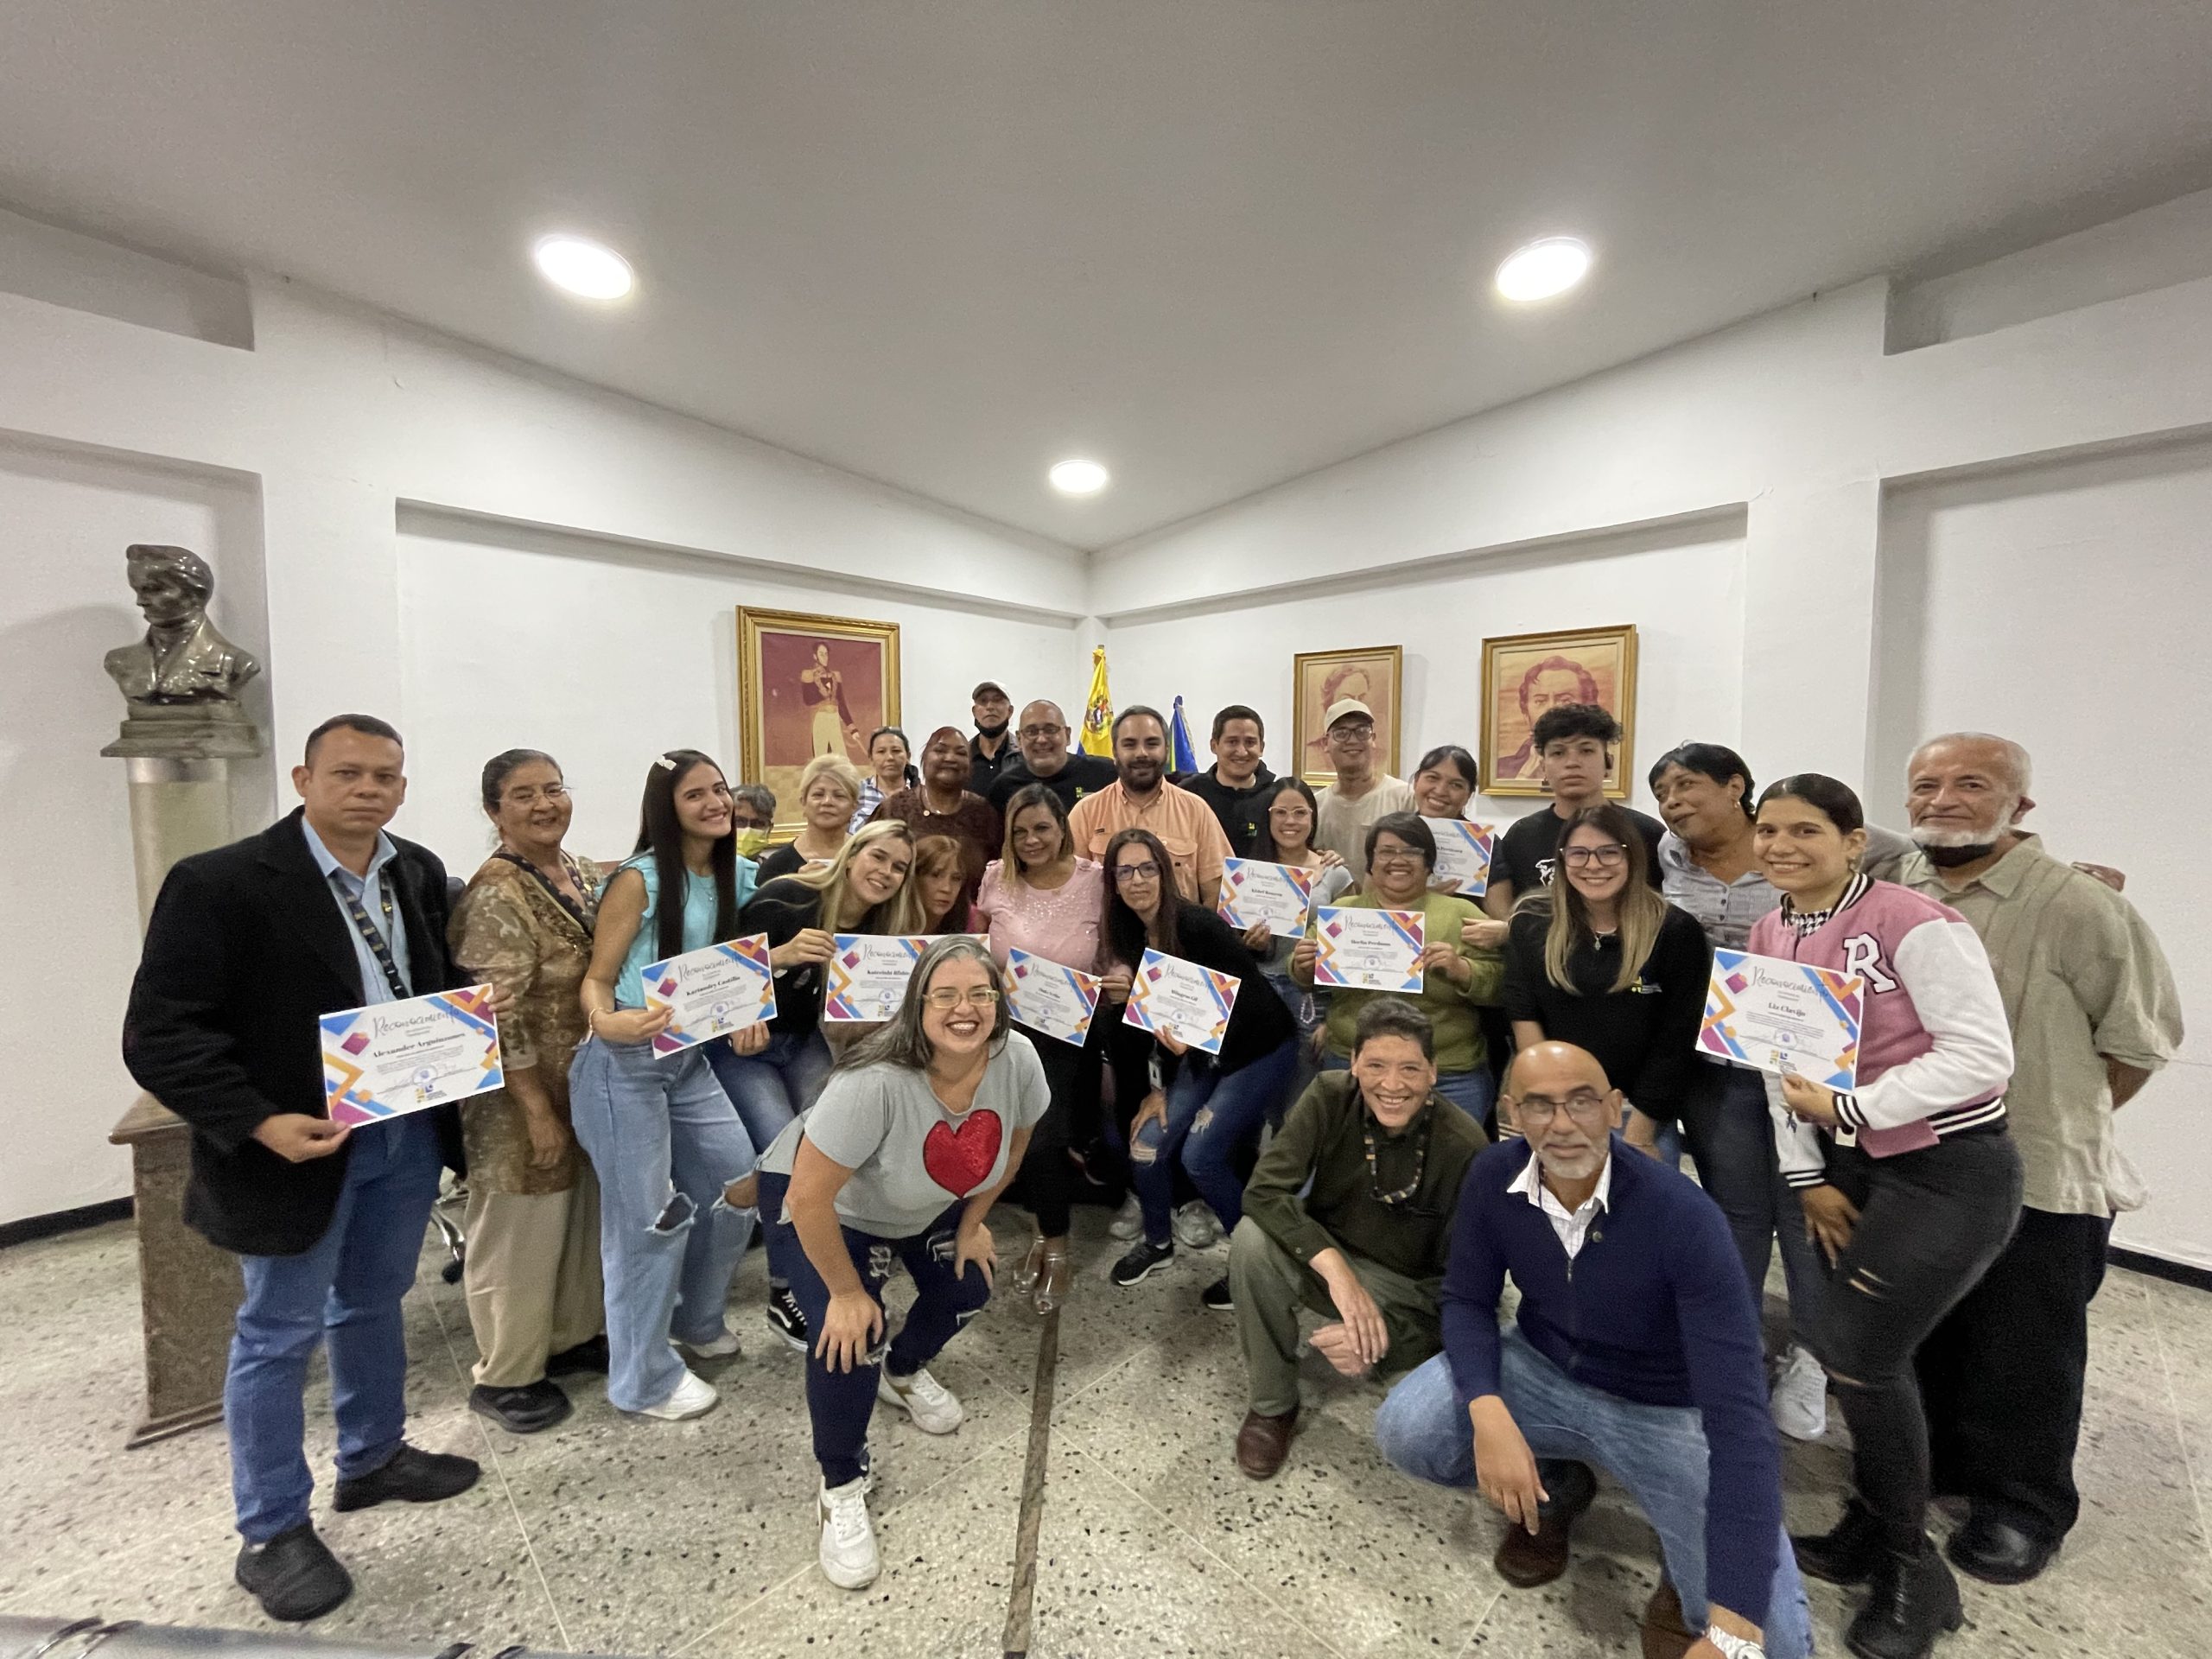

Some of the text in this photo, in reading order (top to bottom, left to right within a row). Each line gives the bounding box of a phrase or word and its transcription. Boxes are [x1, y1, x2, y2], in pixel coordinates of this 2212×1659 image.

[1344, 915, 1399, 936] Reconocimiento
[678, 952, 743, 982] Reconocimiento
[1842, 932, 1899, 995] R
[1751, 966, 1829, 1002] Reconocimiento
[373, 1004, 460, 1039] Reconocimiento
[1781, 1005, 1806, 1017] Clavijo
[373, 1044, 415, 1058] Alexander
